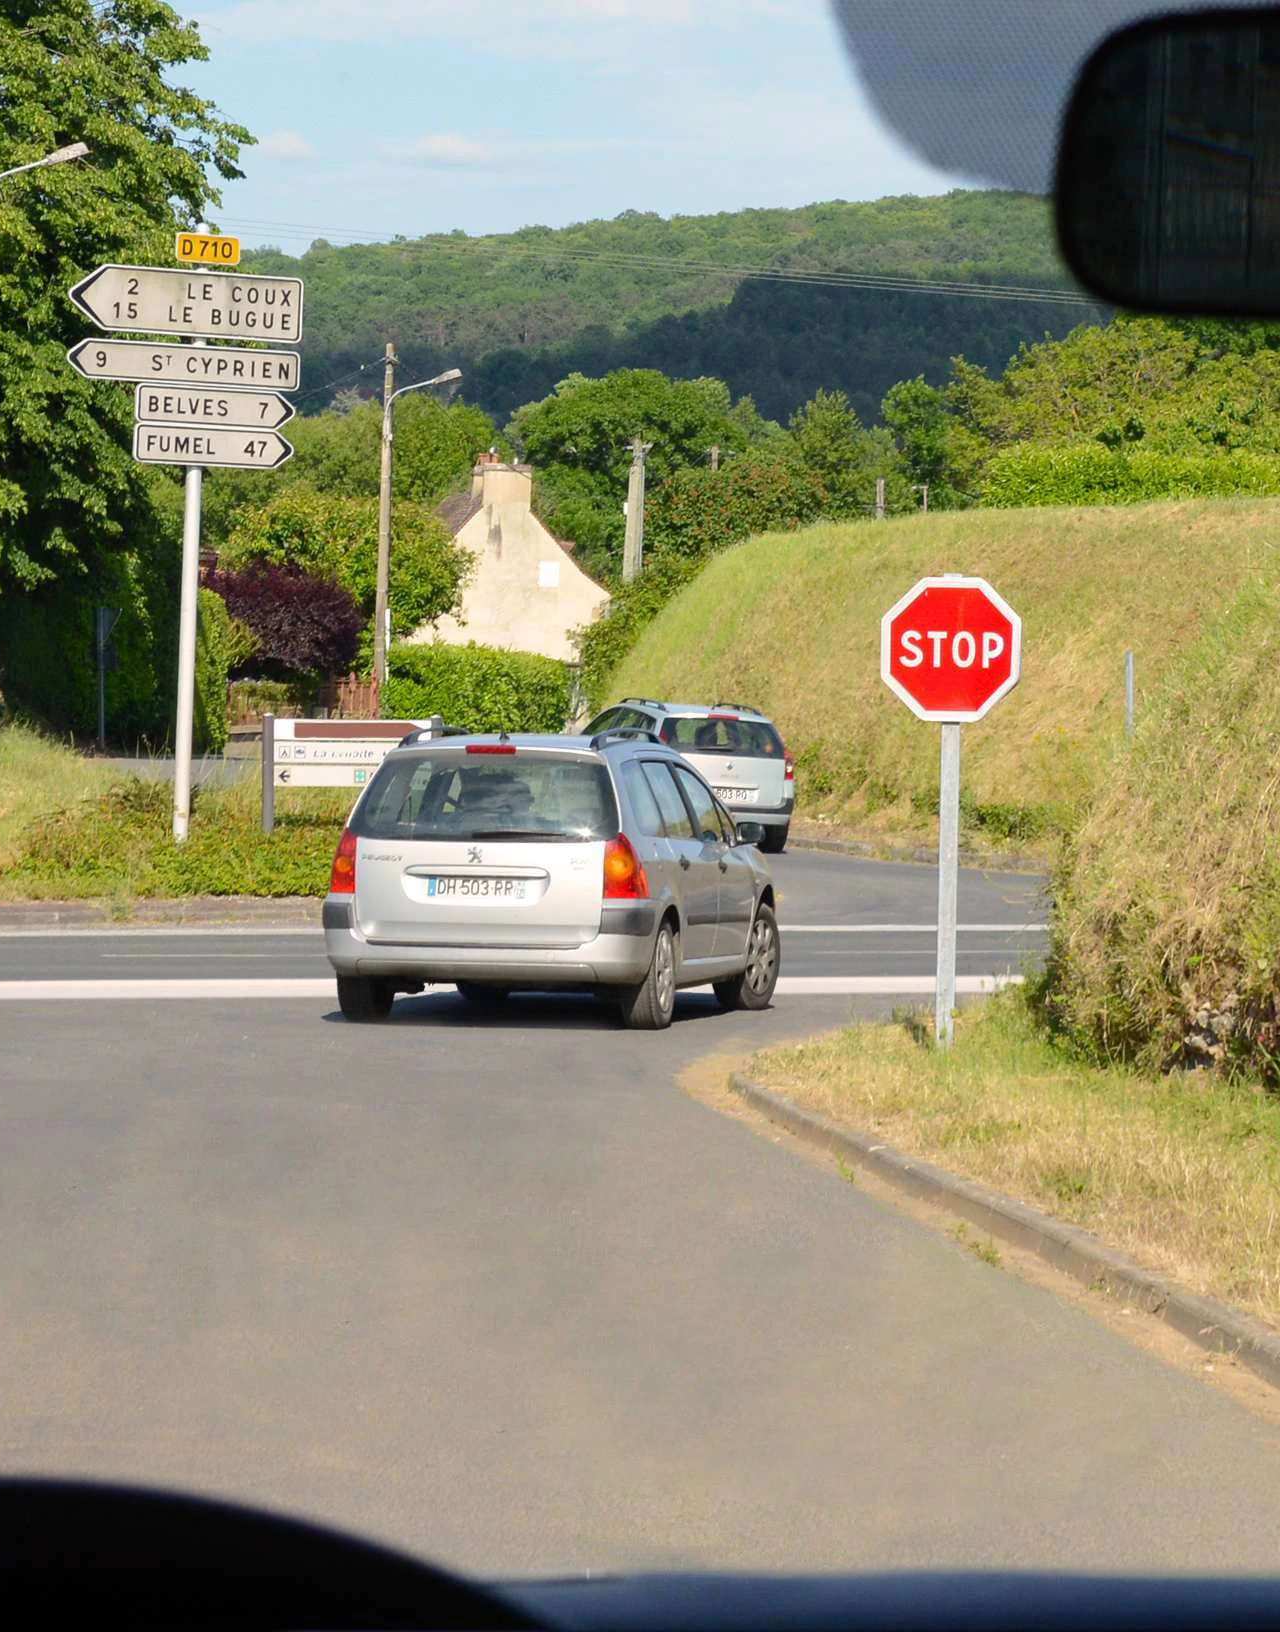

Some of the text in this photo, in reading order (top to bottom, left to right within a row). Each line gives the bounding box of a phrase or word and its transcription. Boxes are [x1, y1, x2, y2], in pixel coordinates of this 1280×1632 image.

[182, 239, 232, 258] D 710
[128, 278, 291, 306] 2 LE COUX
[114, 302, 291, 330] 15 LE BUGUE
[96, 351, 106, 367] 9
[186, 356, 290, 380] CYPRIEN
[149, 396, 268, 418] BELVES 7
[147, 435, 267, 457] FUMEL 47
[900, 630, 1004, 668] STOP
